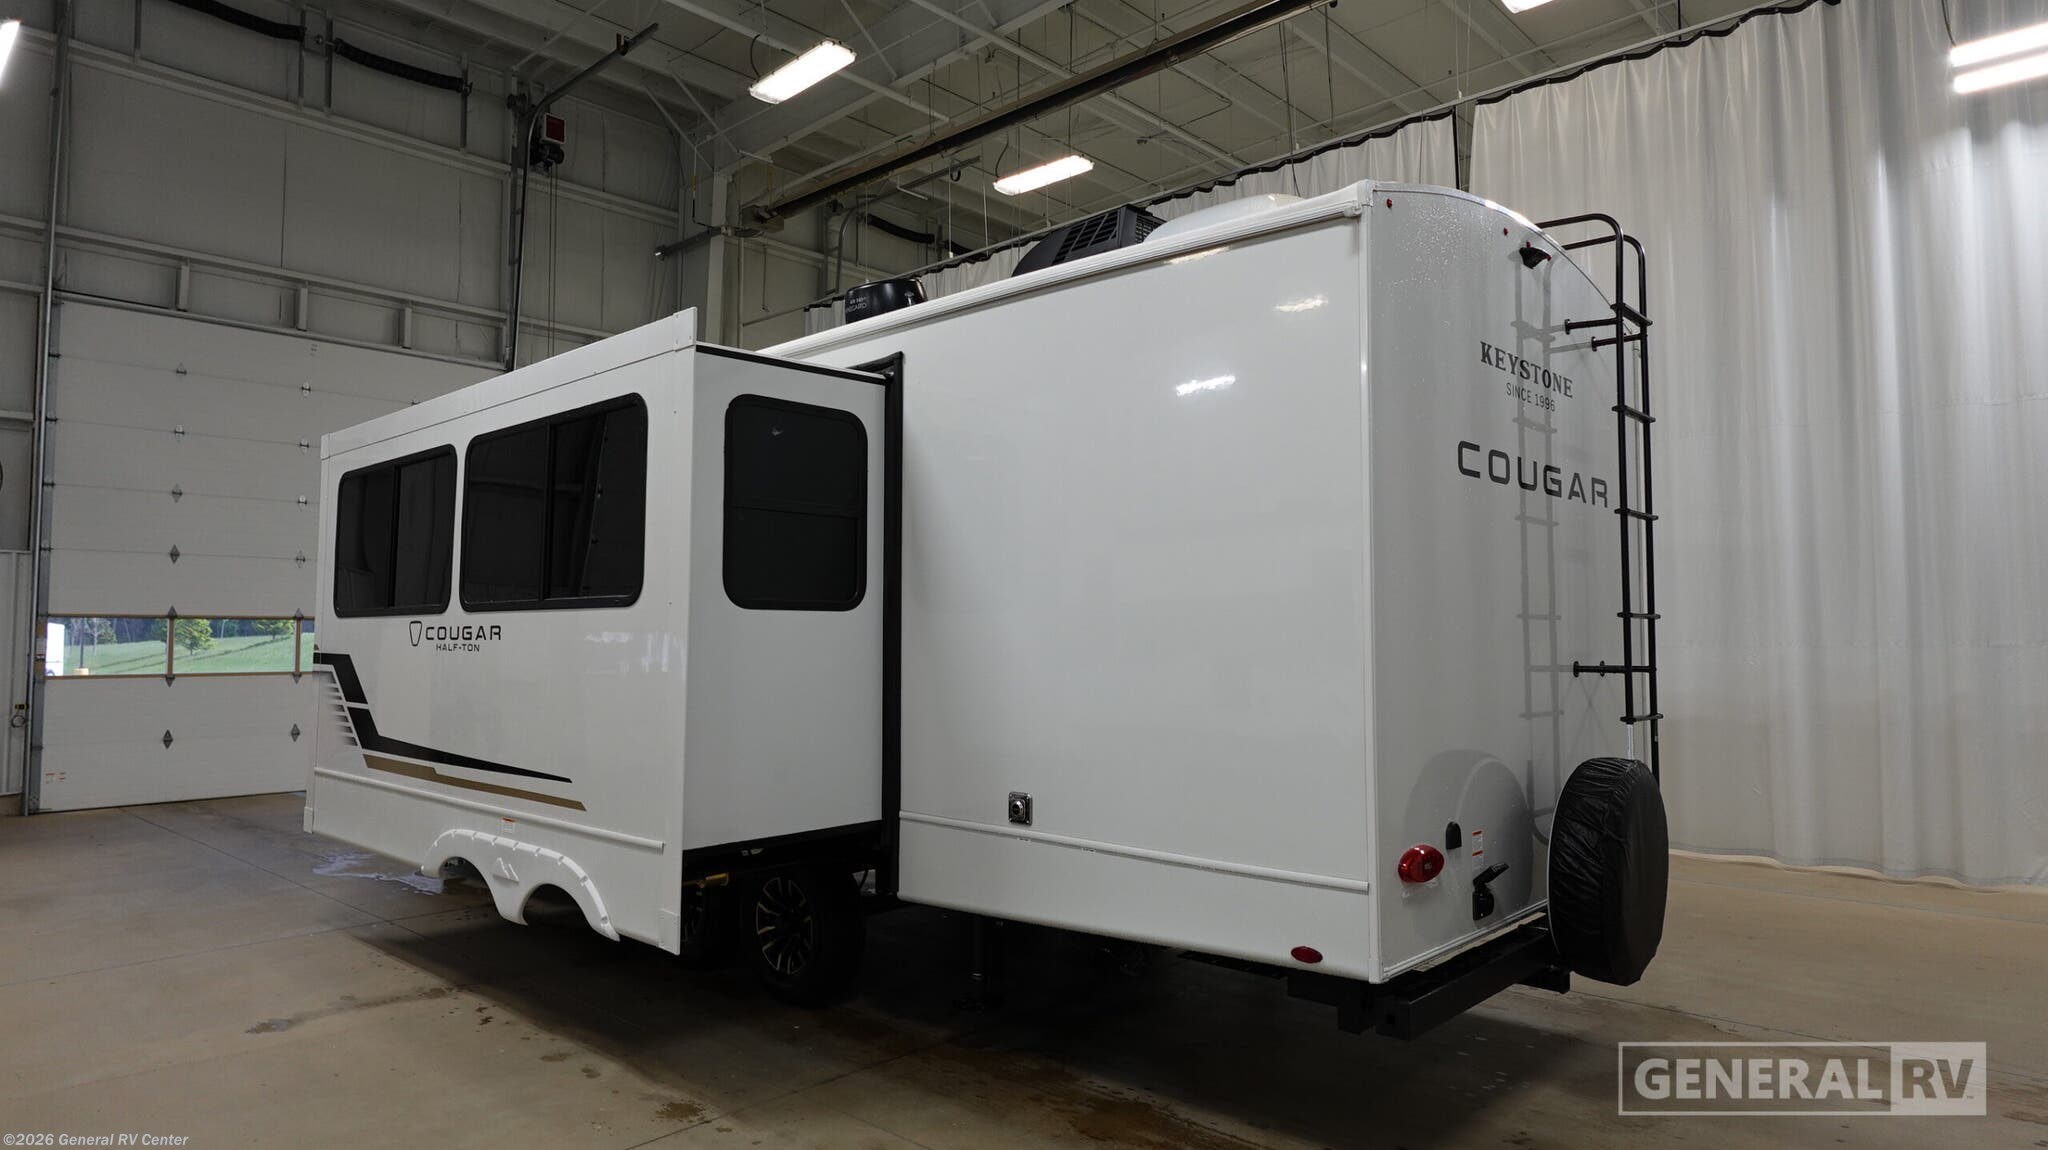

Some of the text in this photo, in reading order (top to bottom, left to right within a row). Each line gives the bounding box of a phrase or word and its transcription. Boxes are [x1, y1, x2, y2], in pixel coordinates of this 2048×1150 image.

[1479, 341, 1574, 399] KEYSTONE
[1506, 382, 1556, 412] SINCE 1996
[1457, 440, 1609, 508] COUGAR
[425, 625, 502, 641] COUGAR
